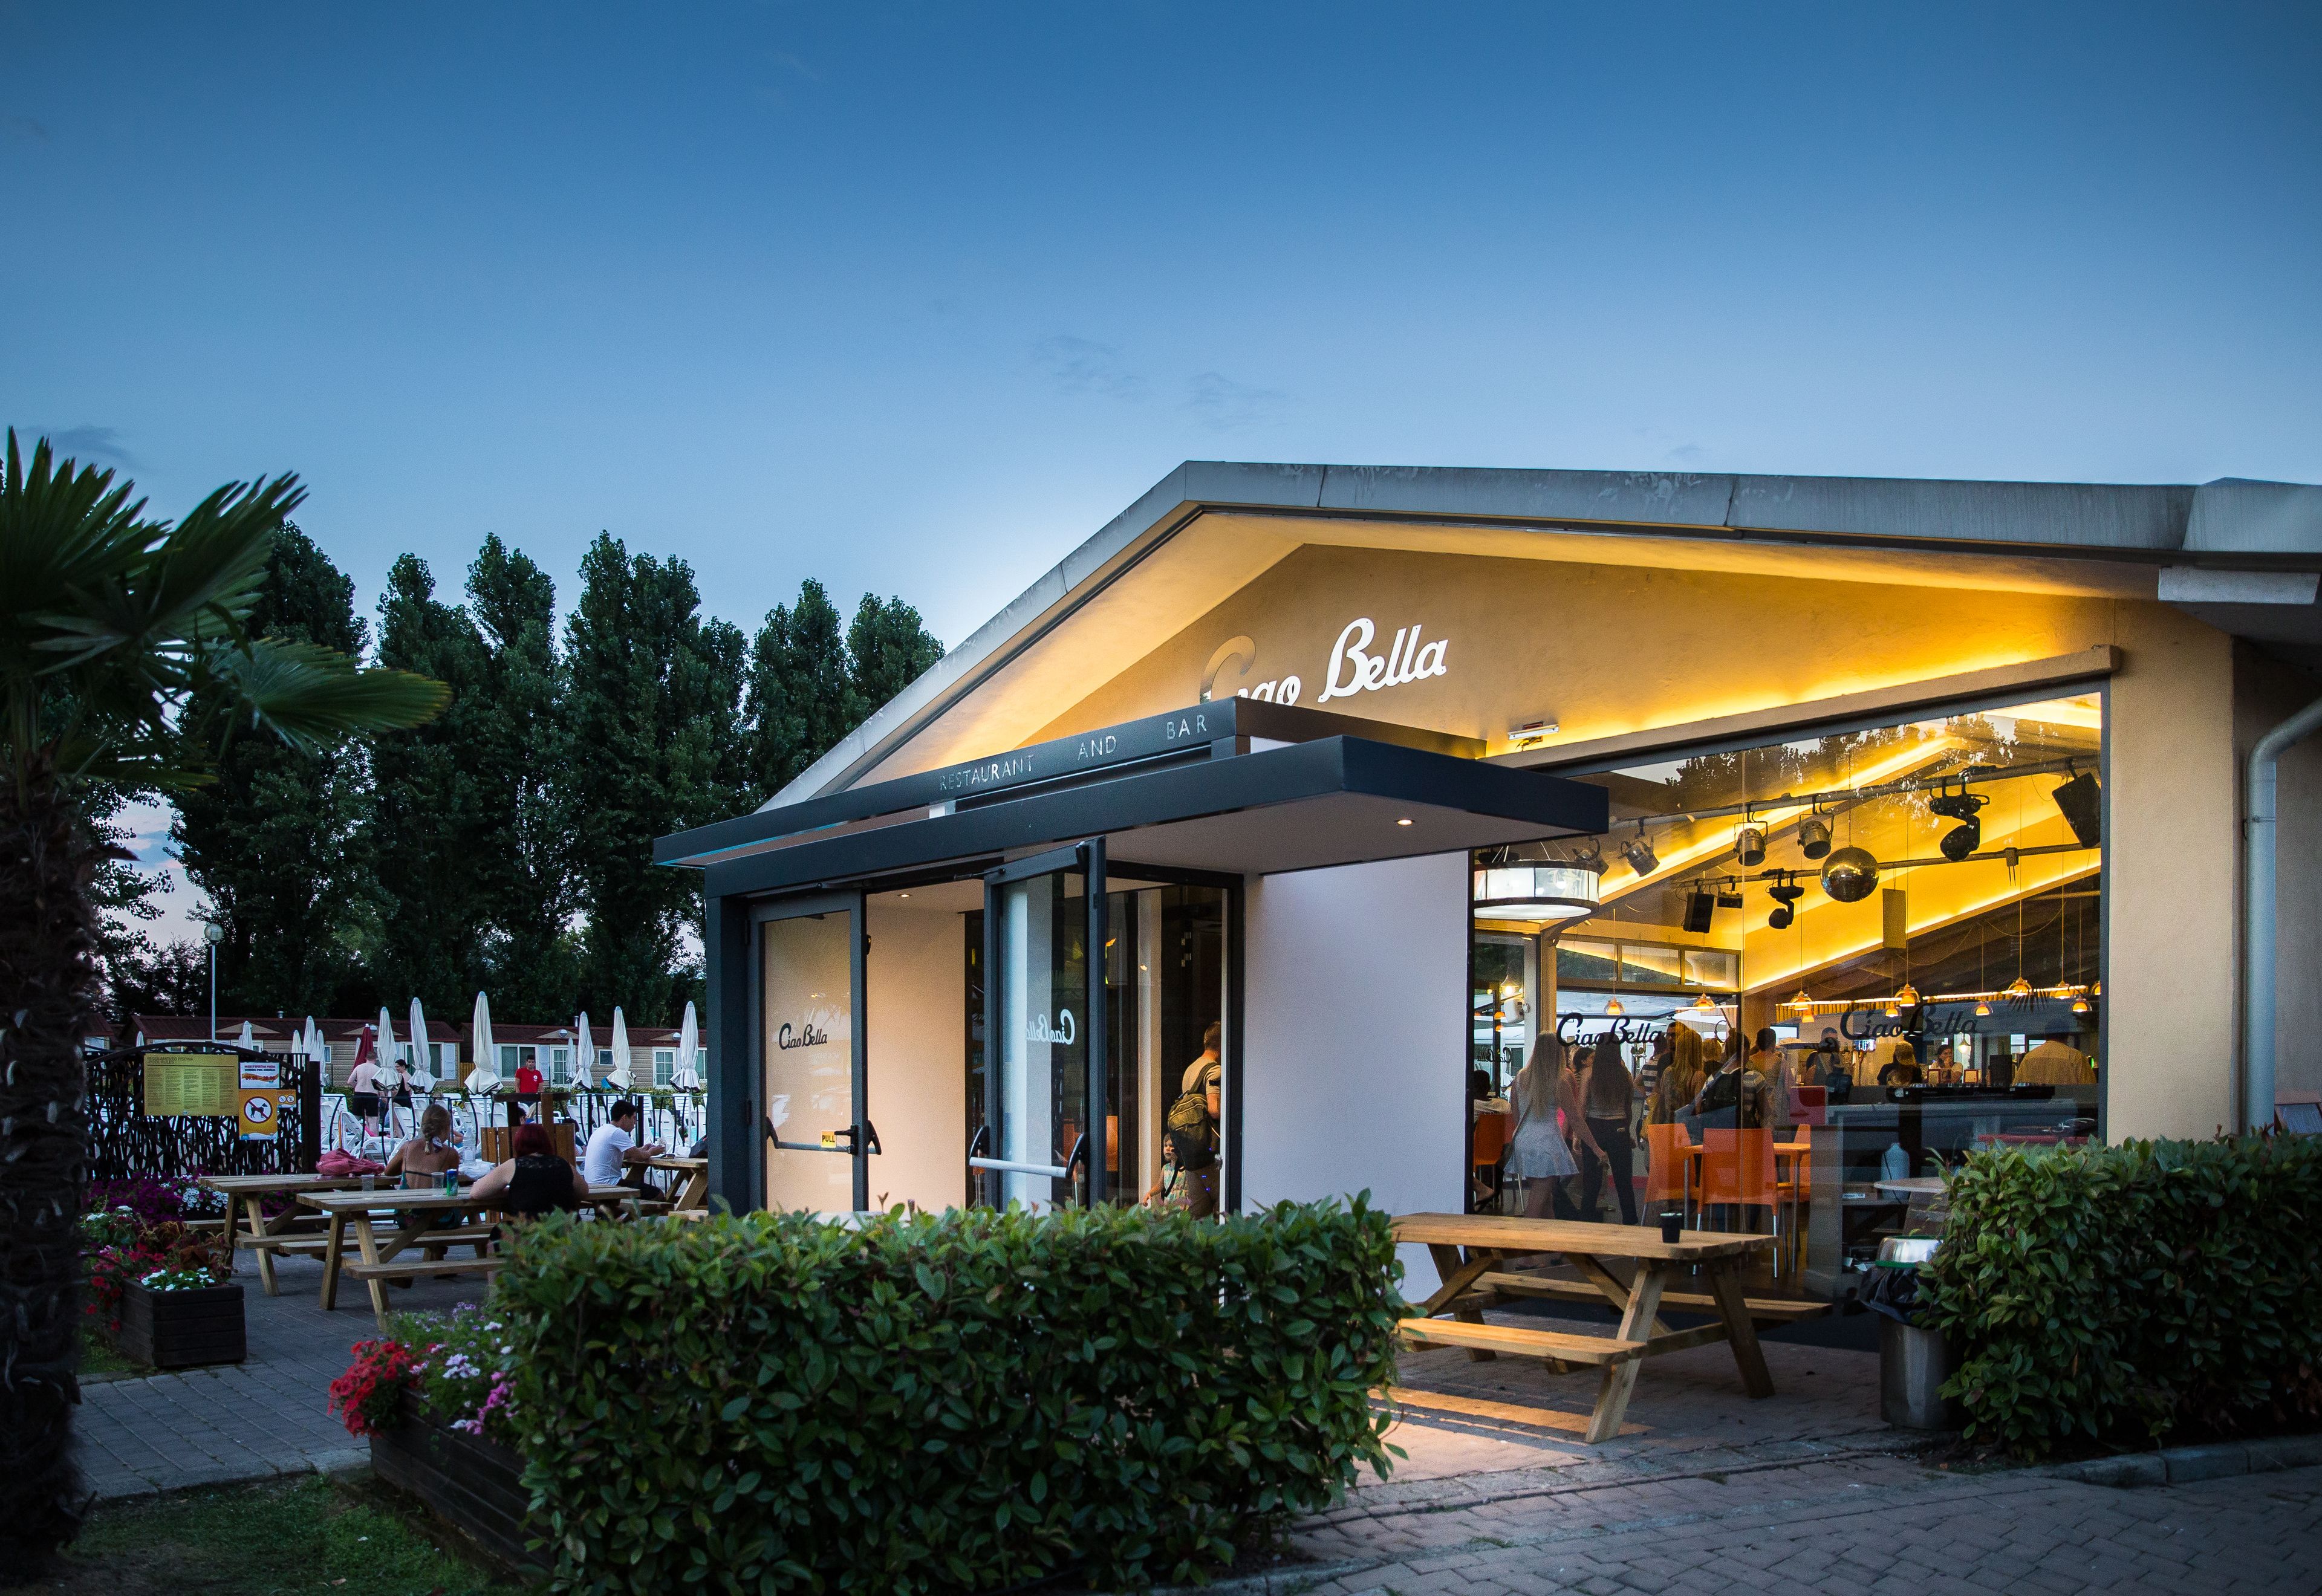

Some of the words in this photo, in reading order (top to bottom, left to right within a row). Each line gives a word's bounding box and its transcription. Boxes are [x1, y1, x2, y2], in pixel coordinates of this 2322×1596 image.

[1200, 635, 1301, 706] Cao
[1317, 617, 1448, 703] Bella
[940, 754, 1035, 790] RESTAURANT
[1078, 735, 1117, 761] AND
[1166, 714, 1207, 740] BAR
[779, 1022, 802, 1050] Ciao
[802, 1023, 828, 1047] Bella
[1556, 1012, 1606, 1046] Ciao
[1608, 1016, 1664, 1044] Bella
